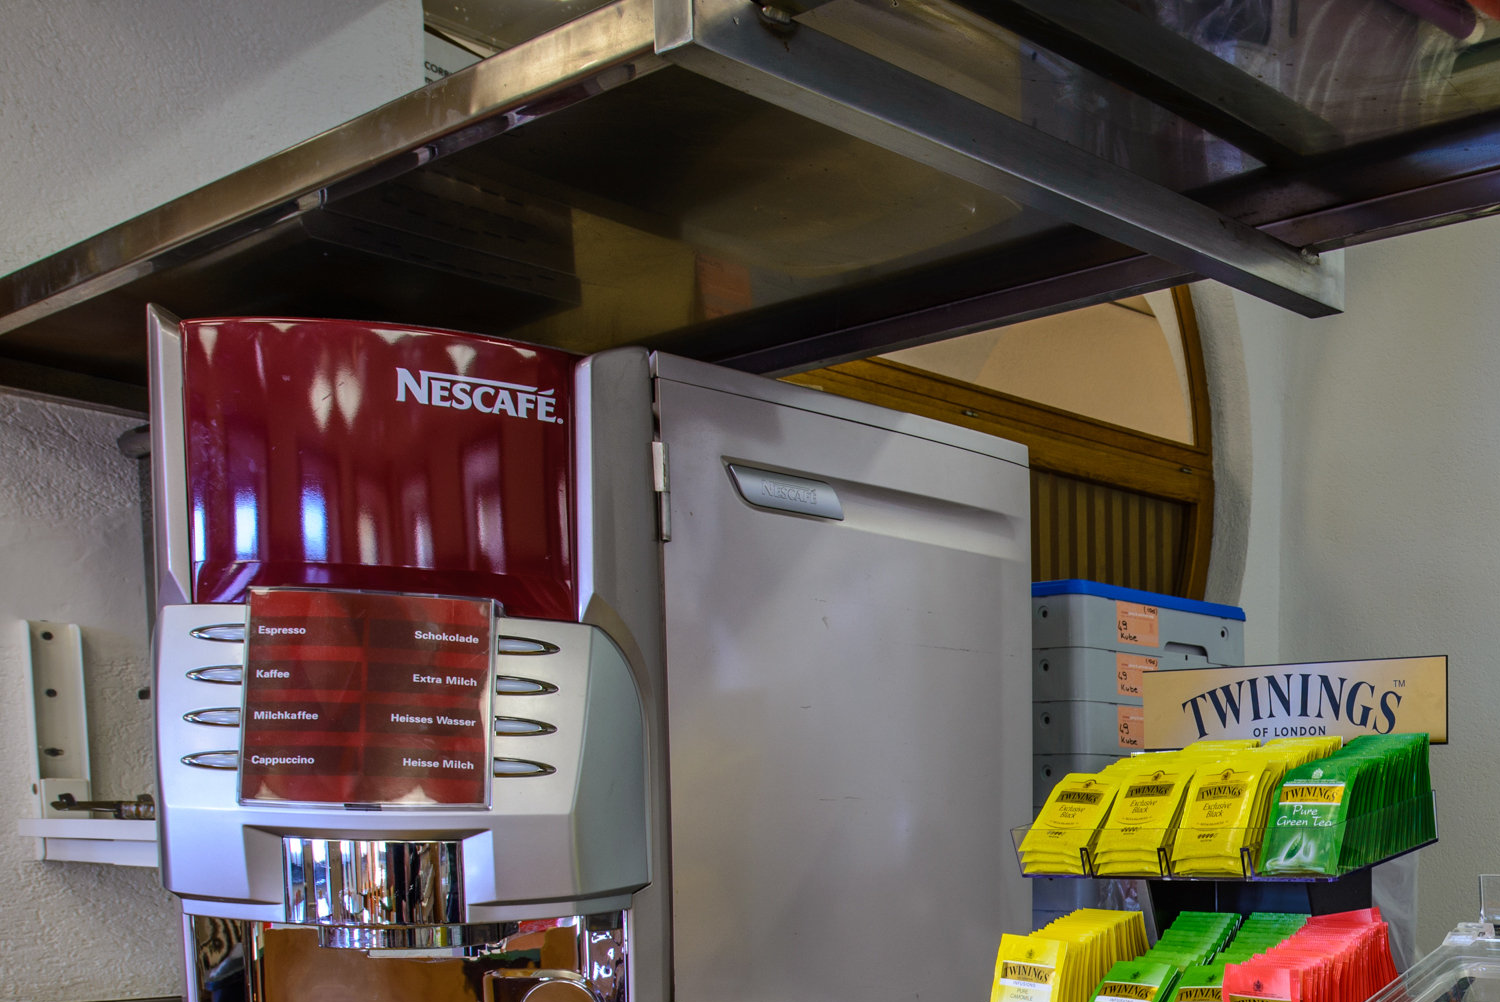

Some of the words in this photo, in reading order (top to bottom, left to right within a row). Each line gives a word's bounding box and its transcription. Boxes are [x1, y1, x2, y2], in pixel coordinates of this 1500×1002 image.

[396, 367, 557, 423] NESCAFÉ
[761, 479, 817, 504] NESCAFÉ
[258, 625, 306, 636] Espresso
[414, 630, 480, 644] Schokolade
[256, 669, 290, 678] Kaffee
[412, 674, 442, 684] Extra
[446, 676, 478, 686] Milch
[1182, 673, 1402, 740] TWININGS
[254, 710, 318, 720] Milchkaffee
[391, 714, 433, 724] Heisses
[436, 716, 476, 726] Wasser
[1253, 728, 1268, 738] OF
[1274, 726, 1326, 737] LONDON
[252, 755, 314, 765] Cappuccino
[402, 758, 440, 768] Heisse
[442, 760, 474, 770] Milch
[1129, 786, 1170, 797] TWININGS
[1200, 786, 1242, 799] TWININGS
[1284, 786, 1338, 802] TWININGS
[1060, 792, 1099, 803] TWININGS
[1130, 798, 1158, 807] Exclusive
[1058, 804, 1086, 813] Exclusive
[1132, 806, 1149, 814] Black
[1203, 802, 1232, 810] Exclusive
[1292, 804, 1318, 816] Pure
[1206, 810, 1224, 818] Black
[1276, 816, 1308, 826] Green
[1312, 816, 1332, 826] Tea
[1004, 965, 1050, 983] TWININGS
[1012, 980, 1036, 988] INFUSIONS
[1103, 982, 1152, 1000] TWININGS
